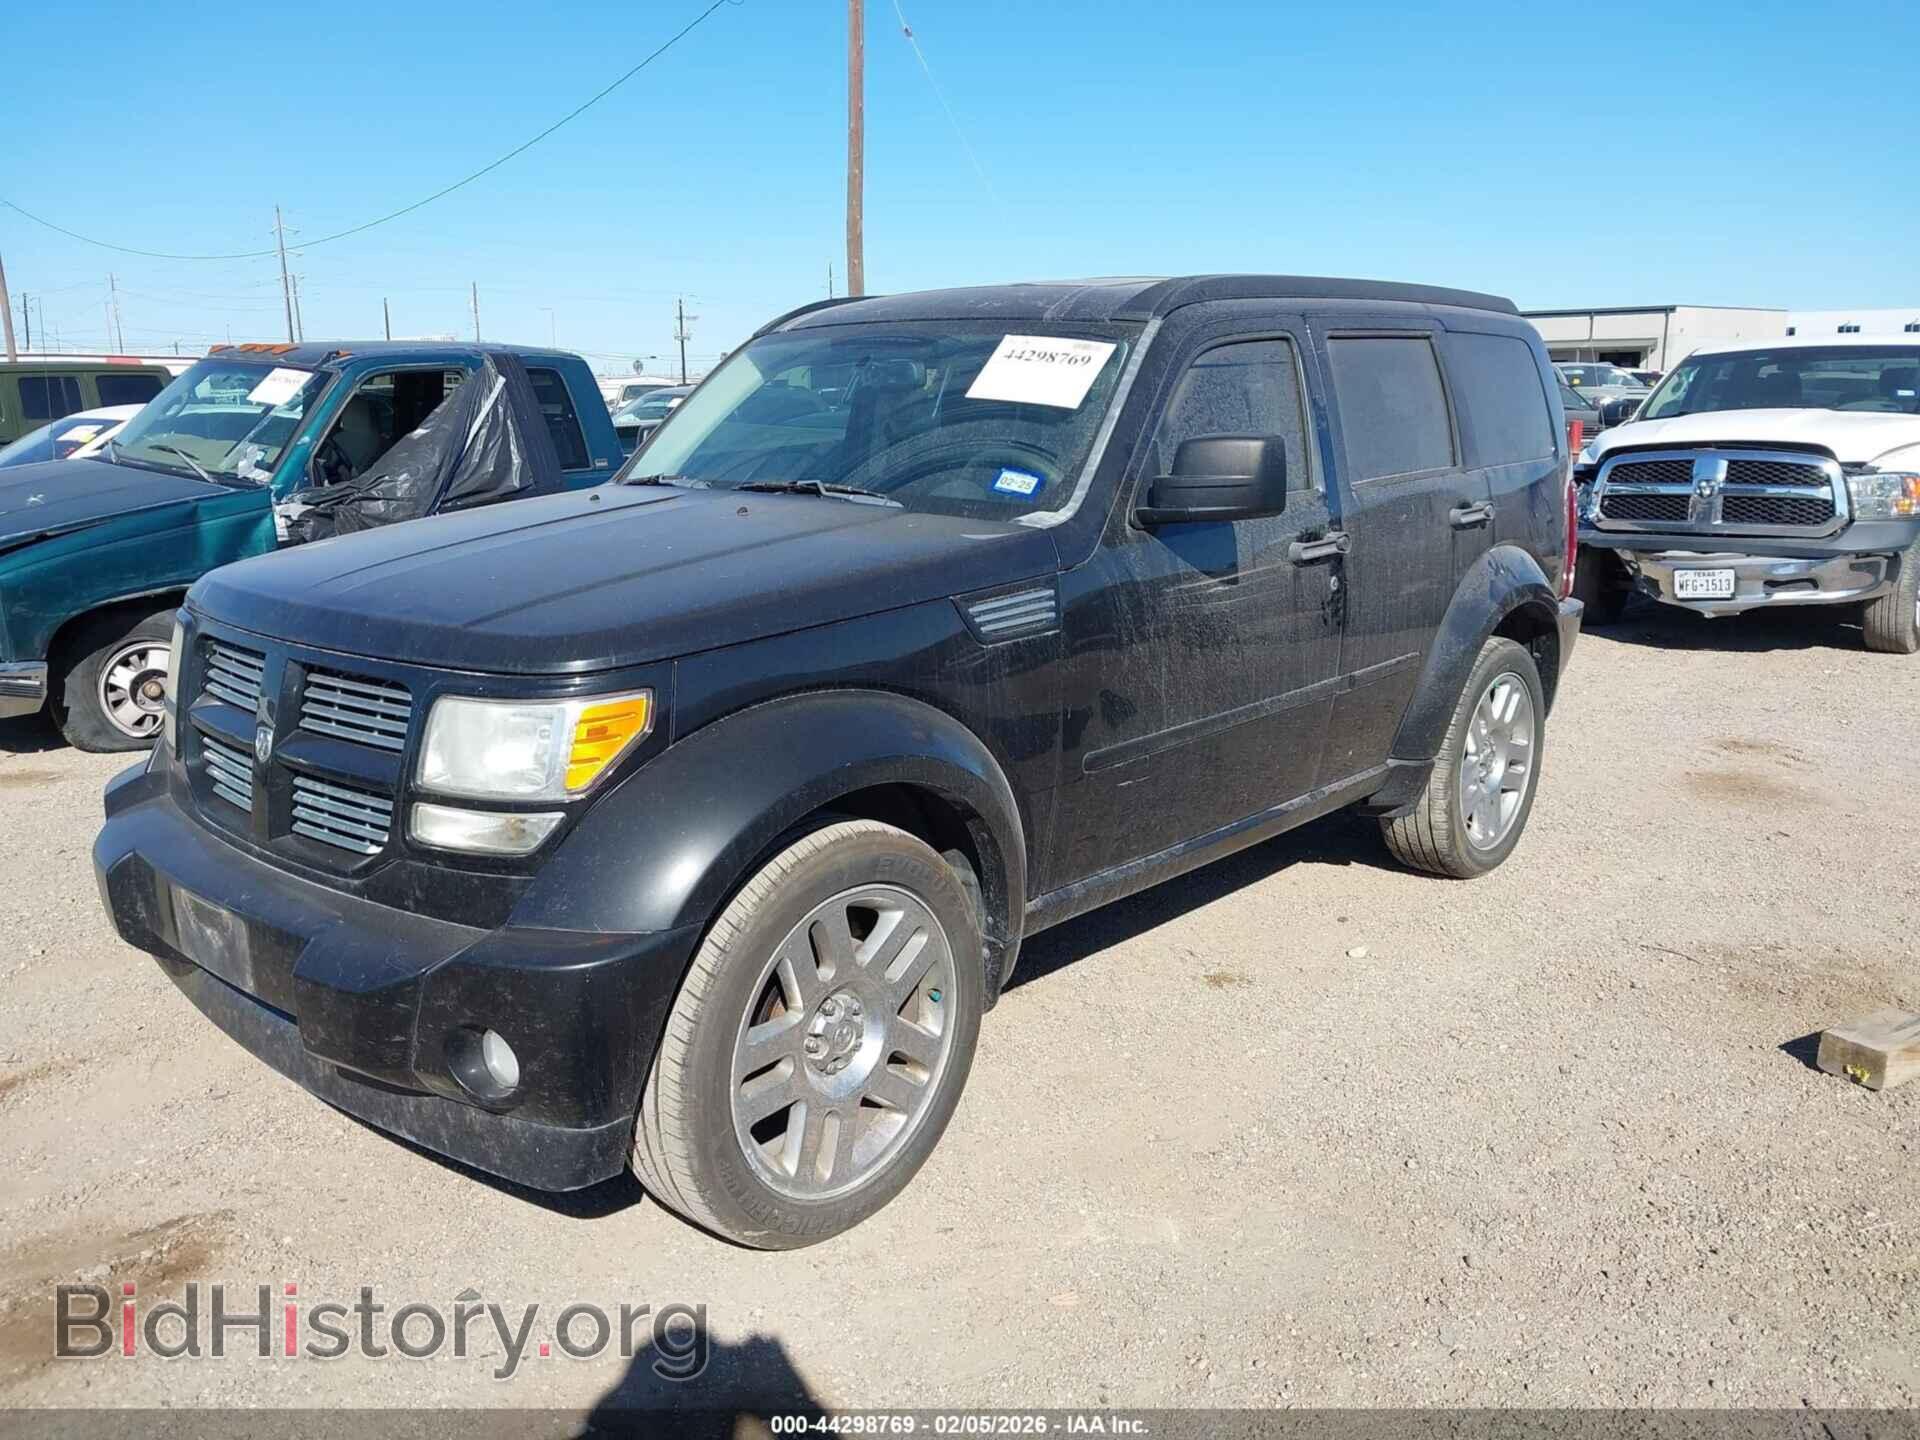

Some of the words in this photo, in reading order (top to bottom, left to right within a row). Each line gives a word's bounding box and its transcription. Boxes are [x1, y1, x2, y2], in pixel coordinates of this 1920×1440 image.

[1003, 349, 1092, 366] 44298769
[1000, 476, 1033, 490] 02-25
[1679, 579, 1730, 592] WFG-1513
